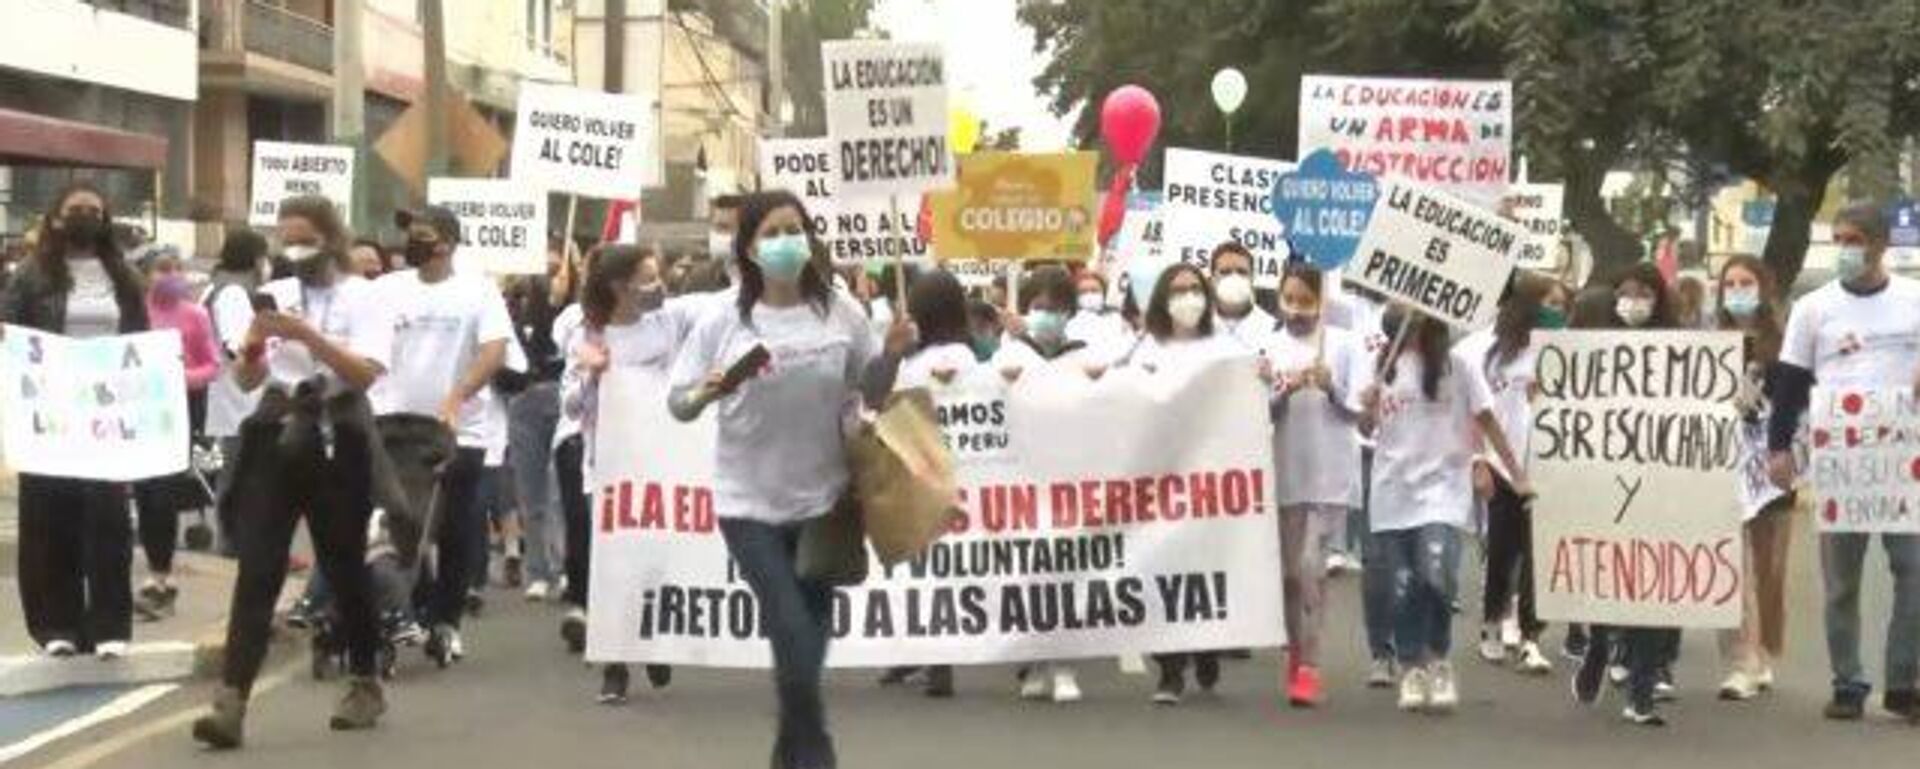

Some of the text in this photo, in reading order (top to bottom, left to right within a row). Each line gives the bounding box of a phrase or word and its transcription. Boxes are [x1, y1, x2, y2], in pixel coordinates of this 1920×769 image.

[832, 60, 853, 90] LA
[868, 97, 913, 127] ES UN
[1313, 85, 1335, 99] LA
[1472, 90, 1503, 111] ES
[530, 110, 635, 139] QUIERO VOLVER
[1331, 117, 1504, 142] UN ARMA DE
[291, 154, 347, 175] ABIERTO
[539, 138, 624, 170] AL COLE!
[774, 152, 828, 176] PODE
[841, 136, 948, 181] DERECHO!
[1336, 147, 1507, 183] ONSTRUCCION
[1211, 162, 1279, 188] CLAS
[1283, 177, 1375, 199] QUIERO VOLVER
[489, 203, 535, 219] VOLVER
[1168, 183, 1273, 215] PRESENC
[1388, 185, 1412, 212] LA
[838, 213, 867, 234] NO
[879, 212, 892, 231] A
[961, 206, 1062, 231] COLEGIO
[1292, 208, 1366, 236] AL COLE!
[477, 225, 527, 248] COLE!
[829, 238, 927, 258] ERSIDAD
[1229, 227, 1276, 250] SON
[1426, 236, 1451, 264] ES
[1364, 250, 1483, 322] PRIMERO!
[1535, 343, 1739, 402] QUEREMOS
[939, 400, 1004, 427] AMOS
[1534, 407, 1594, 462] SER
[1602, 405, 1739, 472] ESCUCHADOS
[602, 481, 666, 534] ¡LA
[979, 483, 1038, 533] UN
[1051, 468, 1264, 529] DERECHO!
[1614, 475, 1643, 524] Y
[1550, 537, 1739, 606] ATENDIDOS
[640, 571, 1228, 639] ¡RETOO A LAS AULAS YA!
